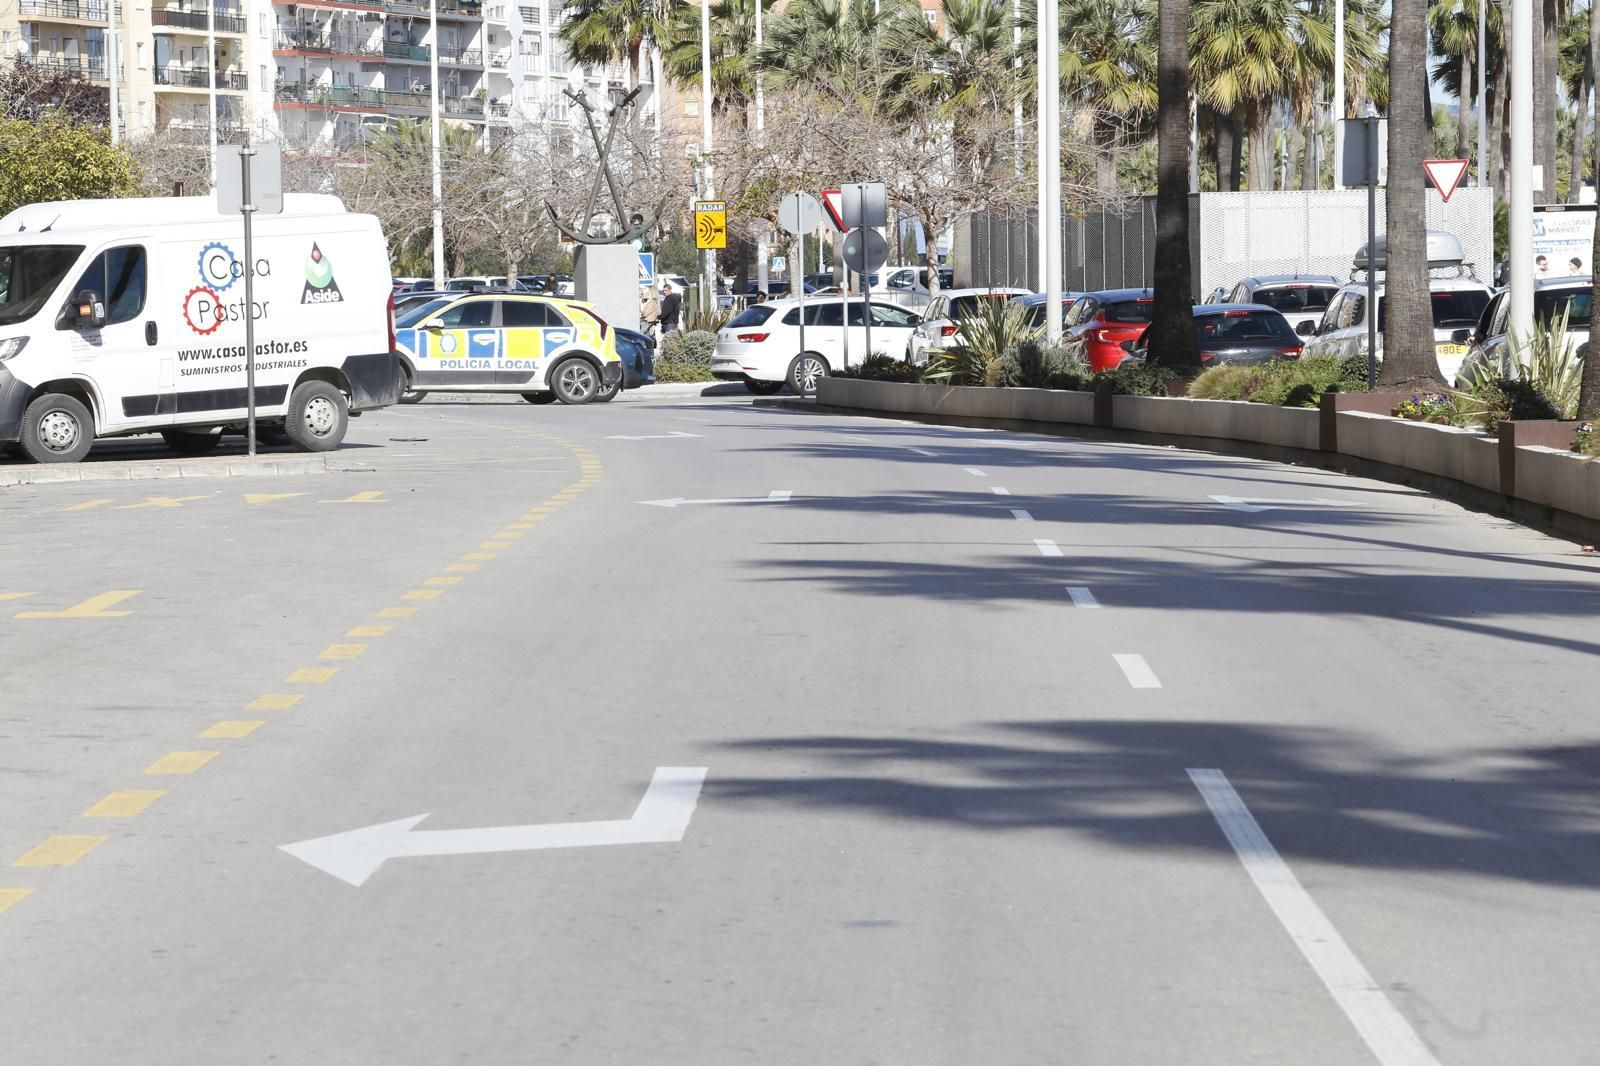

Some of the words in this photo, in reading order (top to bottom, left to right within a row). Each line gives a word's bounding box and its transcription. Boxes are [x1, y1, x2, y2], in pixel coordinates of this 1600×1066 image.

[209, 254, 271, 280] Caa
[304, 288, 340, 304] Aside
[177, 340, 308, 361] www.casaastor.es
[180, 364, 242, 377] SUMINISTROS
[245, 359, 307, 371] IDUSTRIALES
[440, 359, 491, 369] POLICIA
[497, 360, 539, 369] LOCAL
